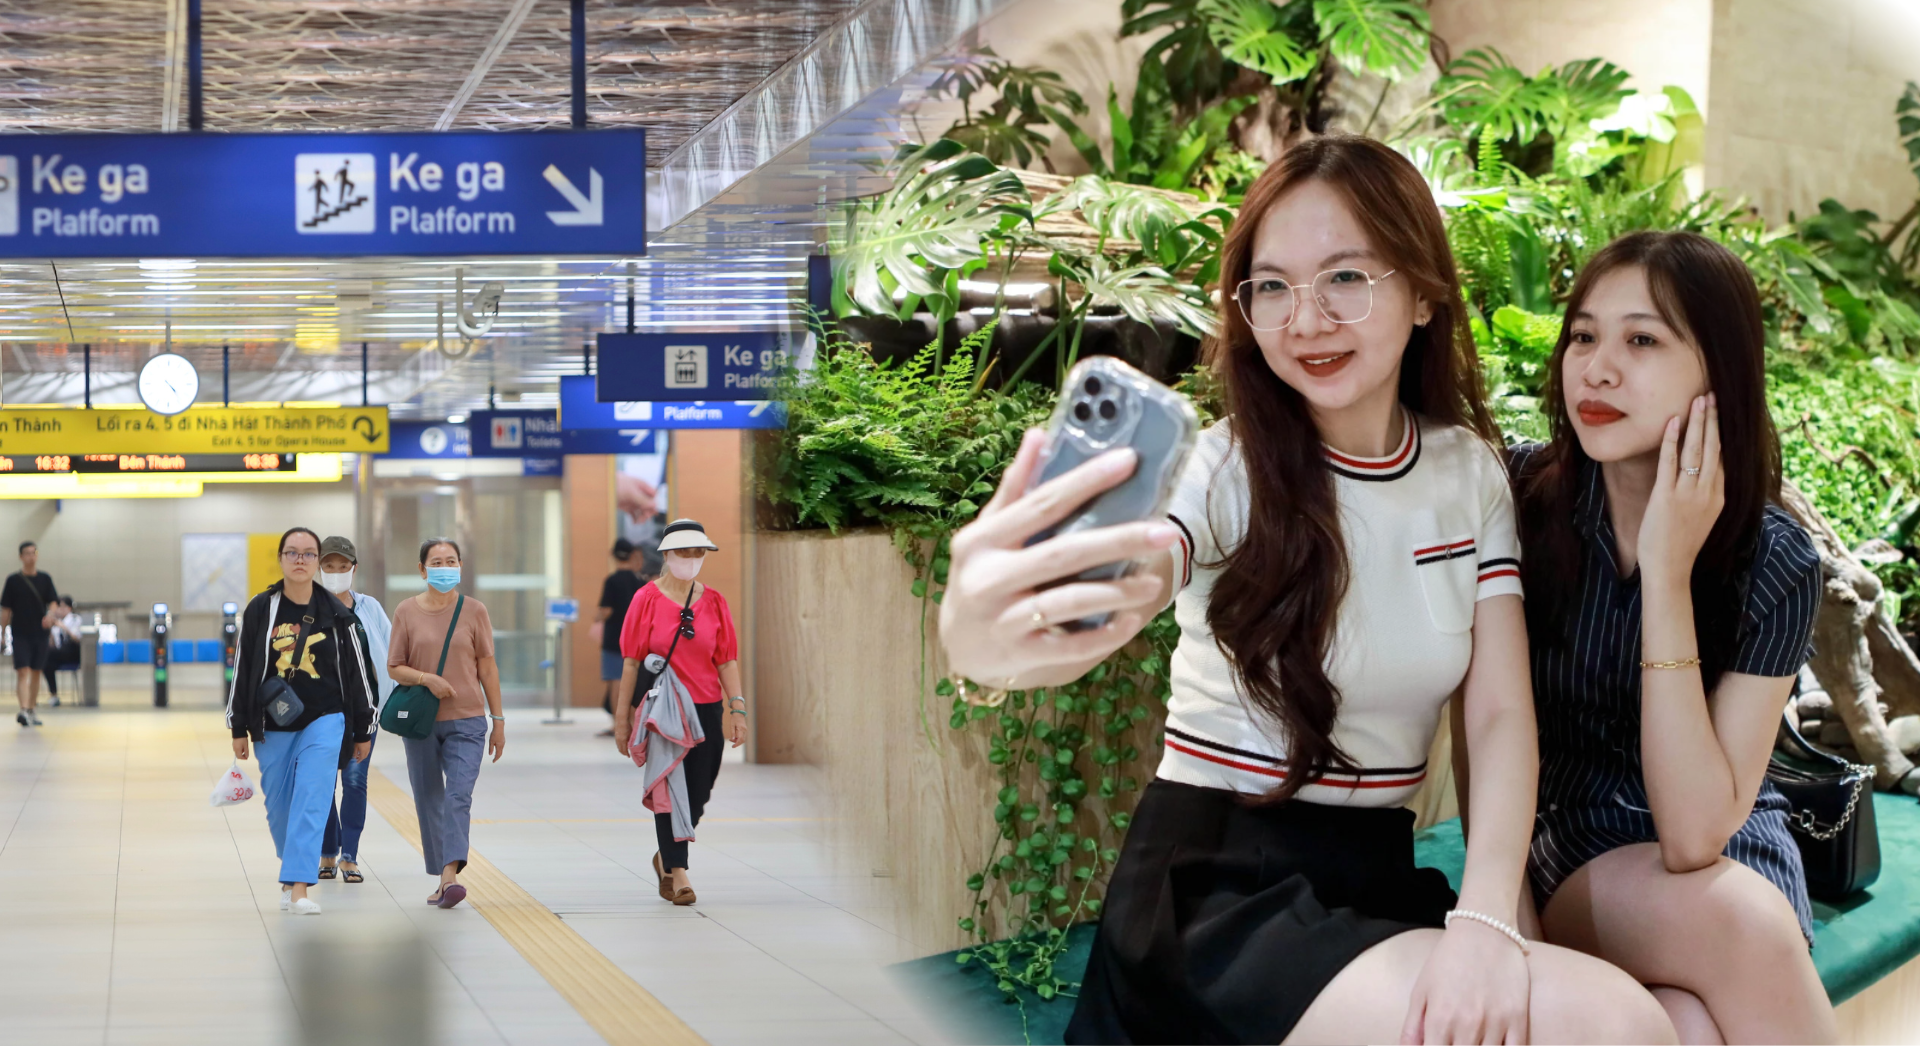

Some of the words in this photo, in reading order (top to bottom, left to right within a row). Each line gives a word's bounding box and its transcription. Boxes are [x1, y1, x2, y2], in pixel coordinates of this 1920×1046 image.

[32, 154, 86, 193] Ke
[99, 162, 149, 202] ga
[390, 153, 444, 192] Ke
[457, 161, 505, 200] ga
[32, 207, 159, 236] Platform
[390, 206, 516, 234] Platform
[724, 345, 753, 366] Ke
[760, 350, 787, 371] ga
[724, 373, 792, 388] Platform
[96, 414, 120, 432] Lối
[125, 420, 141, 431] ra
[164, 415, 173, 430] 5
[197, 415, 228, 431] Nhà
[264, 415, 312, 430] Thành
[316, 413, 347, 430] Phố
[663, 406, 723, 421] Platform
[14, 416, 61, 432] Thành
[212, 435, 232, 446] Exit
[35, 455, 70, 471] 16:32
